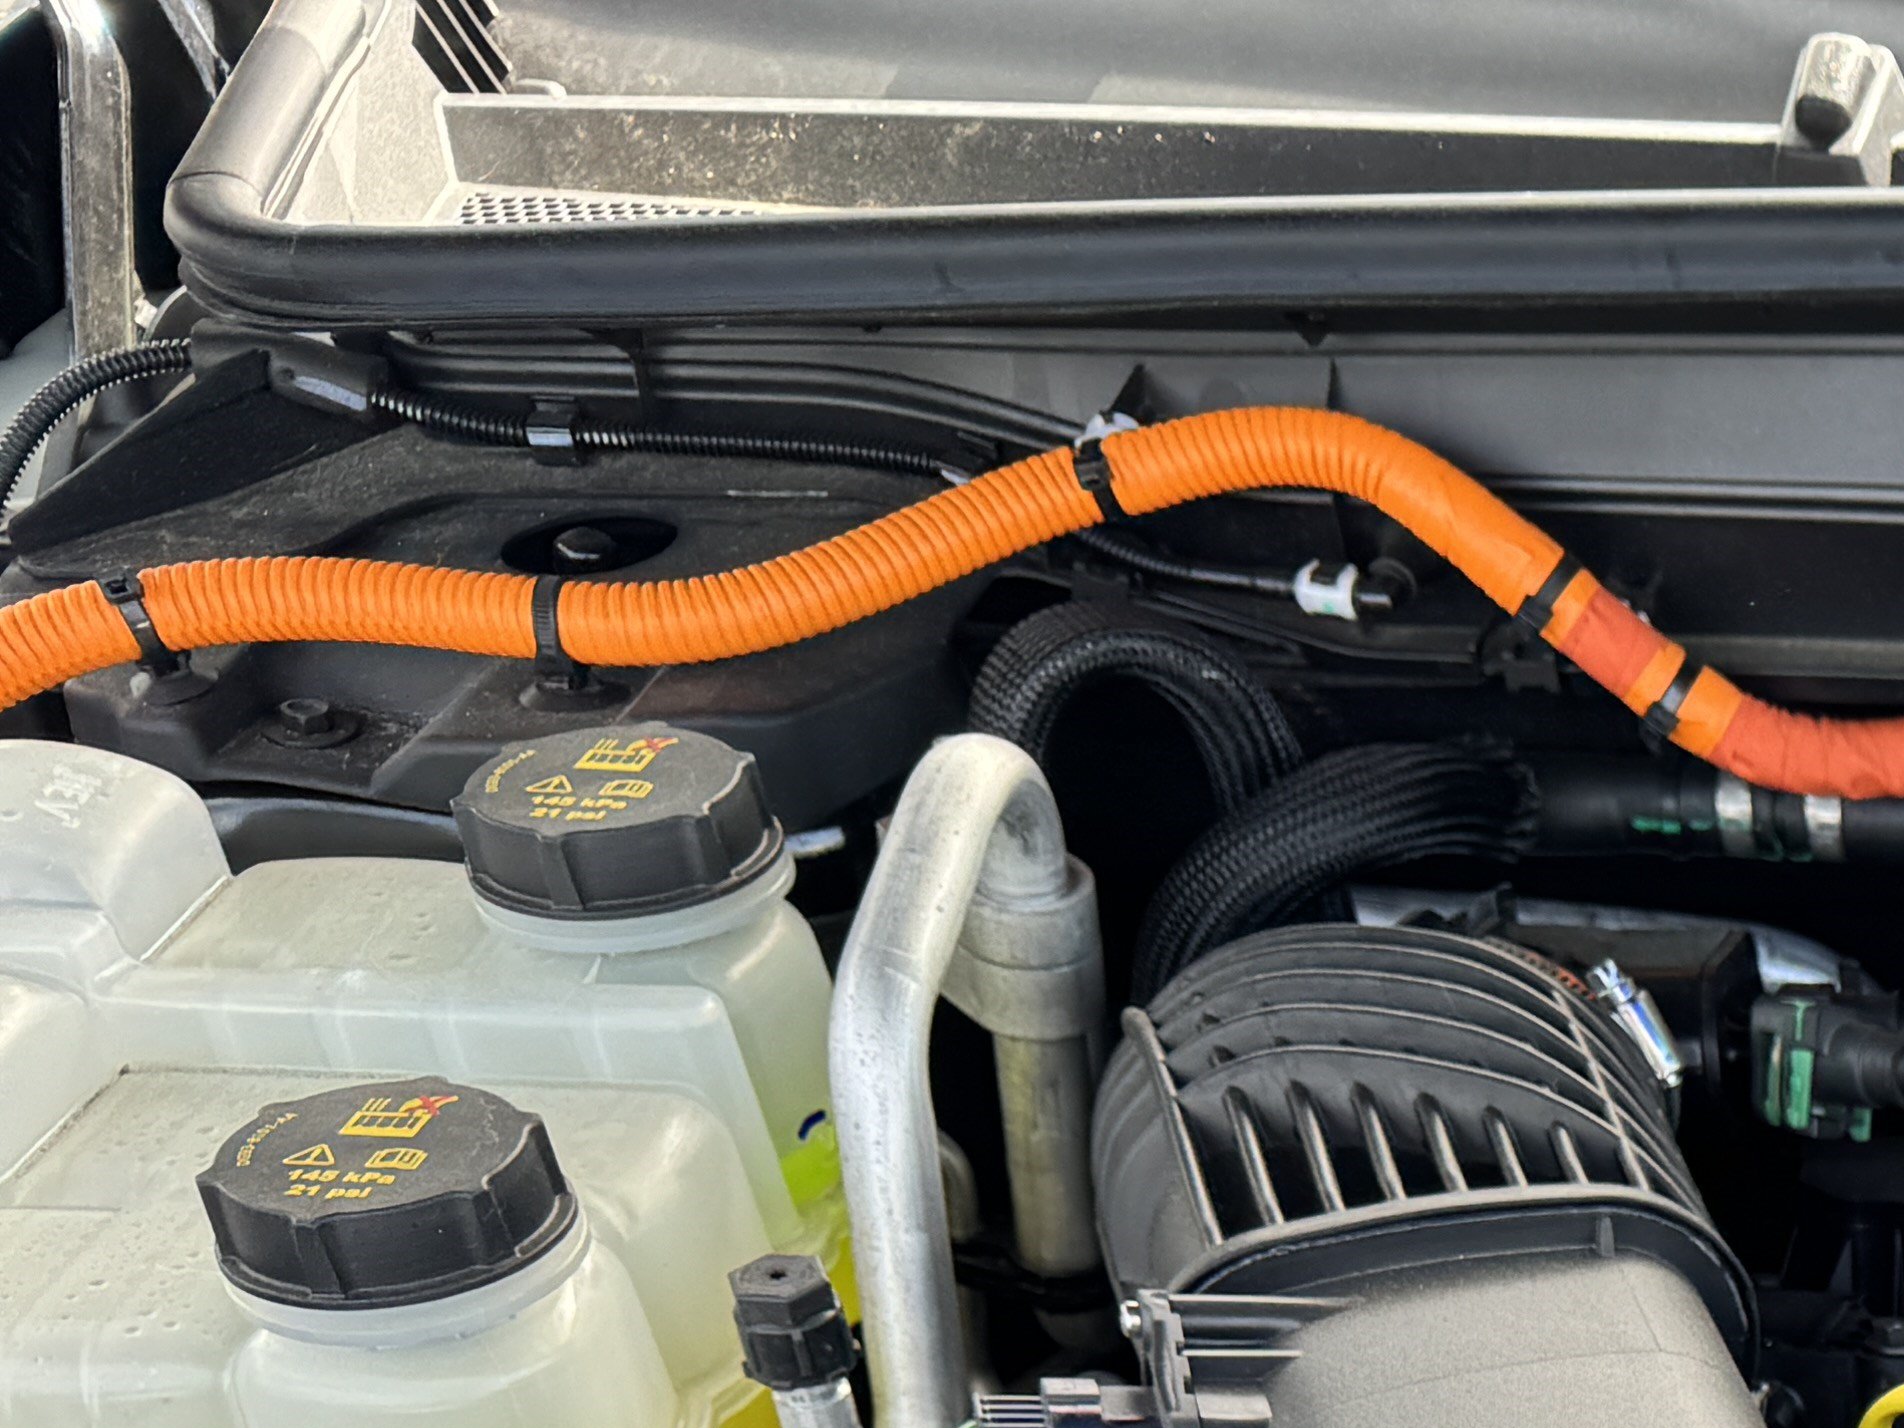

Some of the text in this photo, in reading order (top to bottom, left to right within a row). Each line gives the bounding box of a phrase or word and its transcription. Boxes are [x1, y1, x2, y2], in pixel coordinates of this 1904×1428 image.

[288, 1169, 395, 1185] 145 kPa
[284, 1184, 321, 1196] 21
